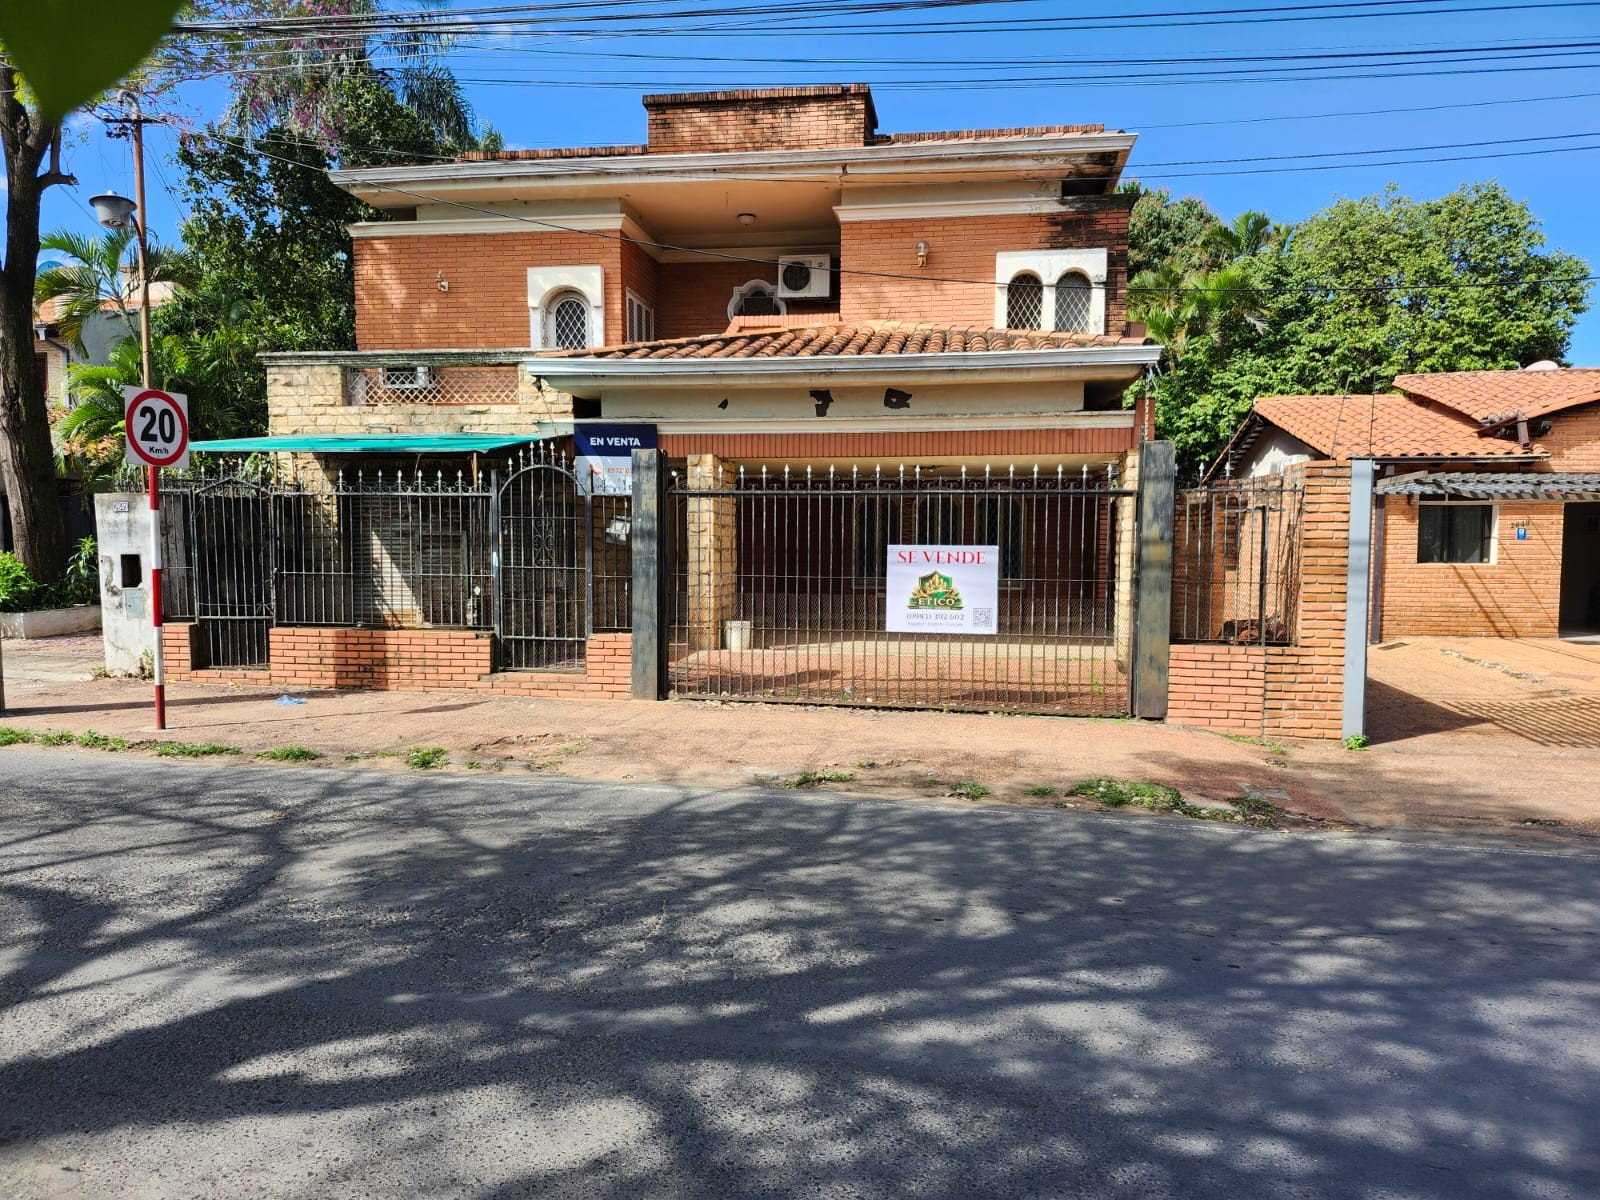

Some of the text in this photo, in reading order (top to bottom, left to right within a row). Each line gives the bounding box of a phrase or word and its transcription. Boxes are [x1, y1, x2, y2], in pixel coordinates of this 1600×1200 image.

[140, 406, 175, 444] 20
[590, 437, 641, 446] EN VENTA
[149, 446, 169, 455] Km/h
[897, 551, 986, 564] SE VENDE
[918, 598, 955, 606] ETICO
[949, 613, 965, 622] 602
